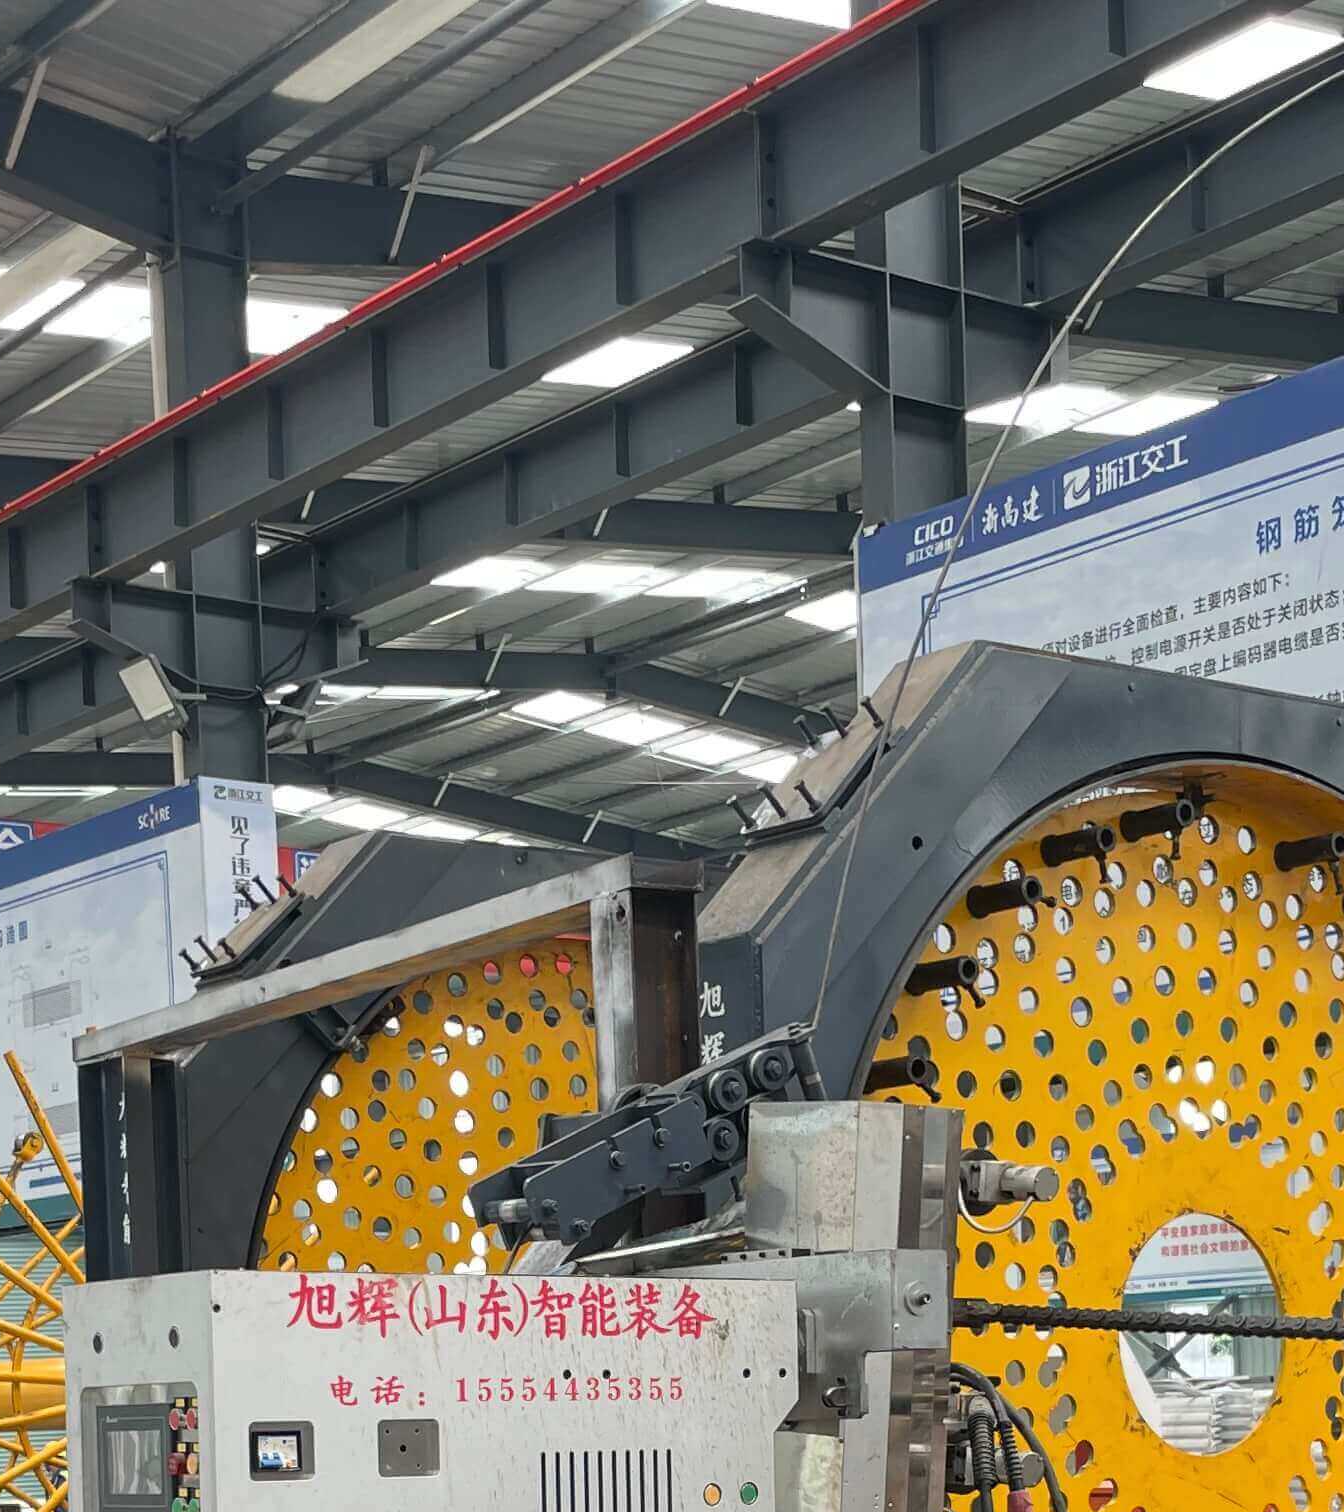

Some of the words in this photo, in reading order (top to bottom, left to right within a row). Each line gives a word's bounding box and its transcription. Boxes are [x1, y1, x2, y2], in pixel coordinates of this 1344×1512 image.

[1095, 435, 1189, 497] 浙江交工
[455, 1376, 685, 1402] 15554435355
